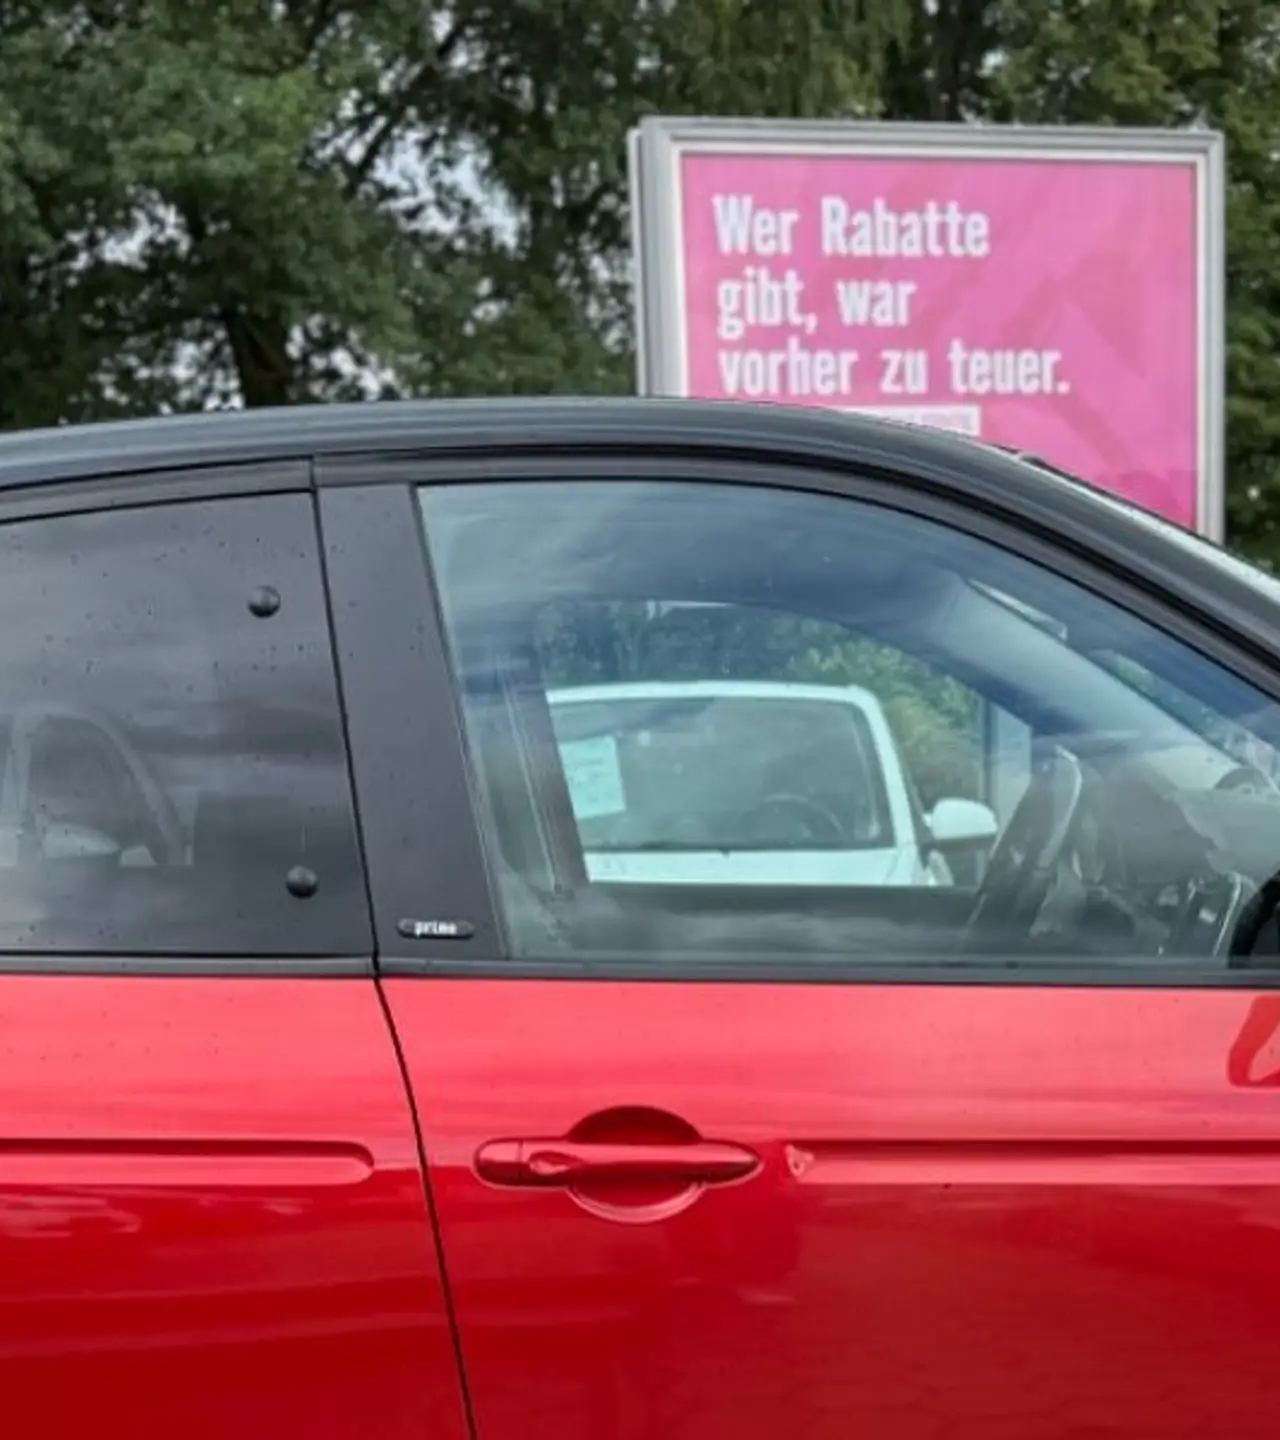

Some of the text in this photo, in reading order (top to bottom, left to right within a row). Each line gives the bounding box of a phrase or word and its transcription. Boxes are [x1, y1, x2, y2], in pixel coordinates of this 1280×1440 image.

[711, 193, 989, 258] Wer Rabatte
[716, 266, 917, 338] gibt, war
[717, 337, 1070, 396] vorher zu teuer.
